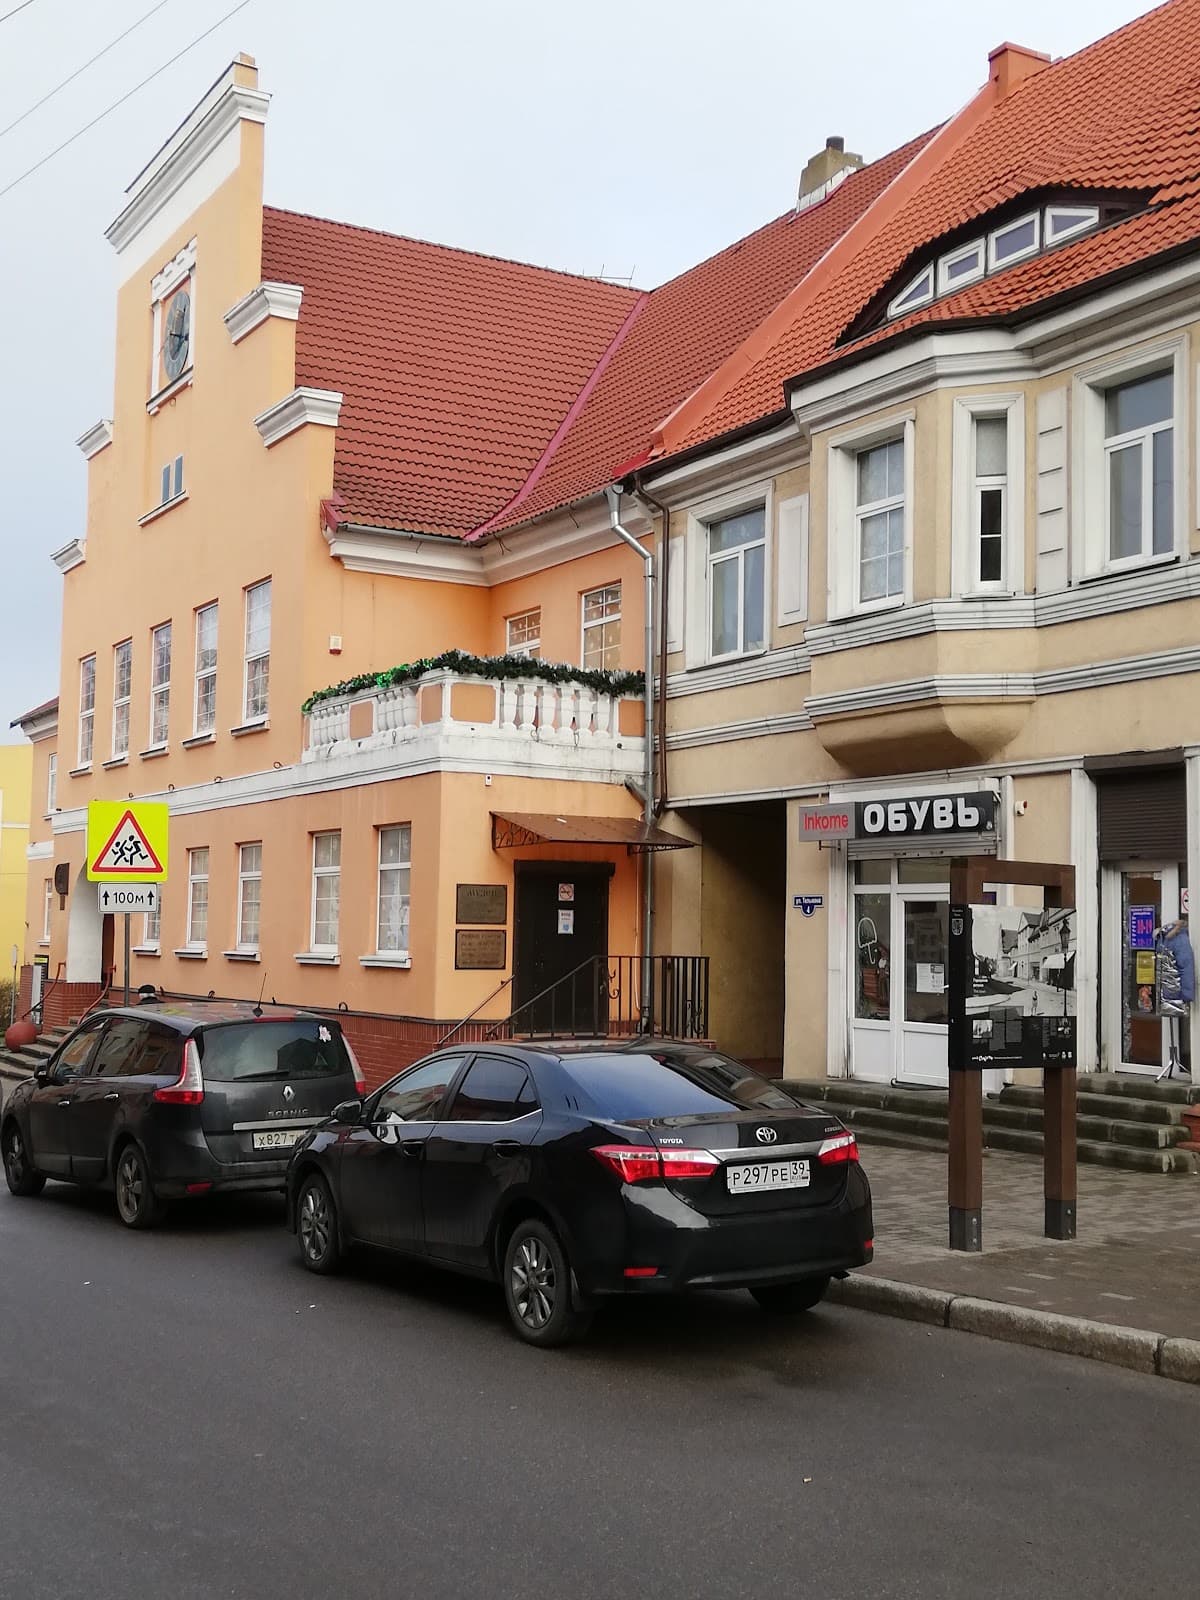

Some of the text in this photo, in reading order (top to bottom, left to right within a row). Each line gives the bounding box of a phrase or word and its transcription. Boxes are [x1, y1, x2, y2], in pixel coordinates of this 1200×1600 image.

[803, 812, 849, 831] Inkome
[863, 797, 980, 833] ОБУВЬ
[112, 892, 144, 904] 100м
[791, 1162, 805, 1176] 39
